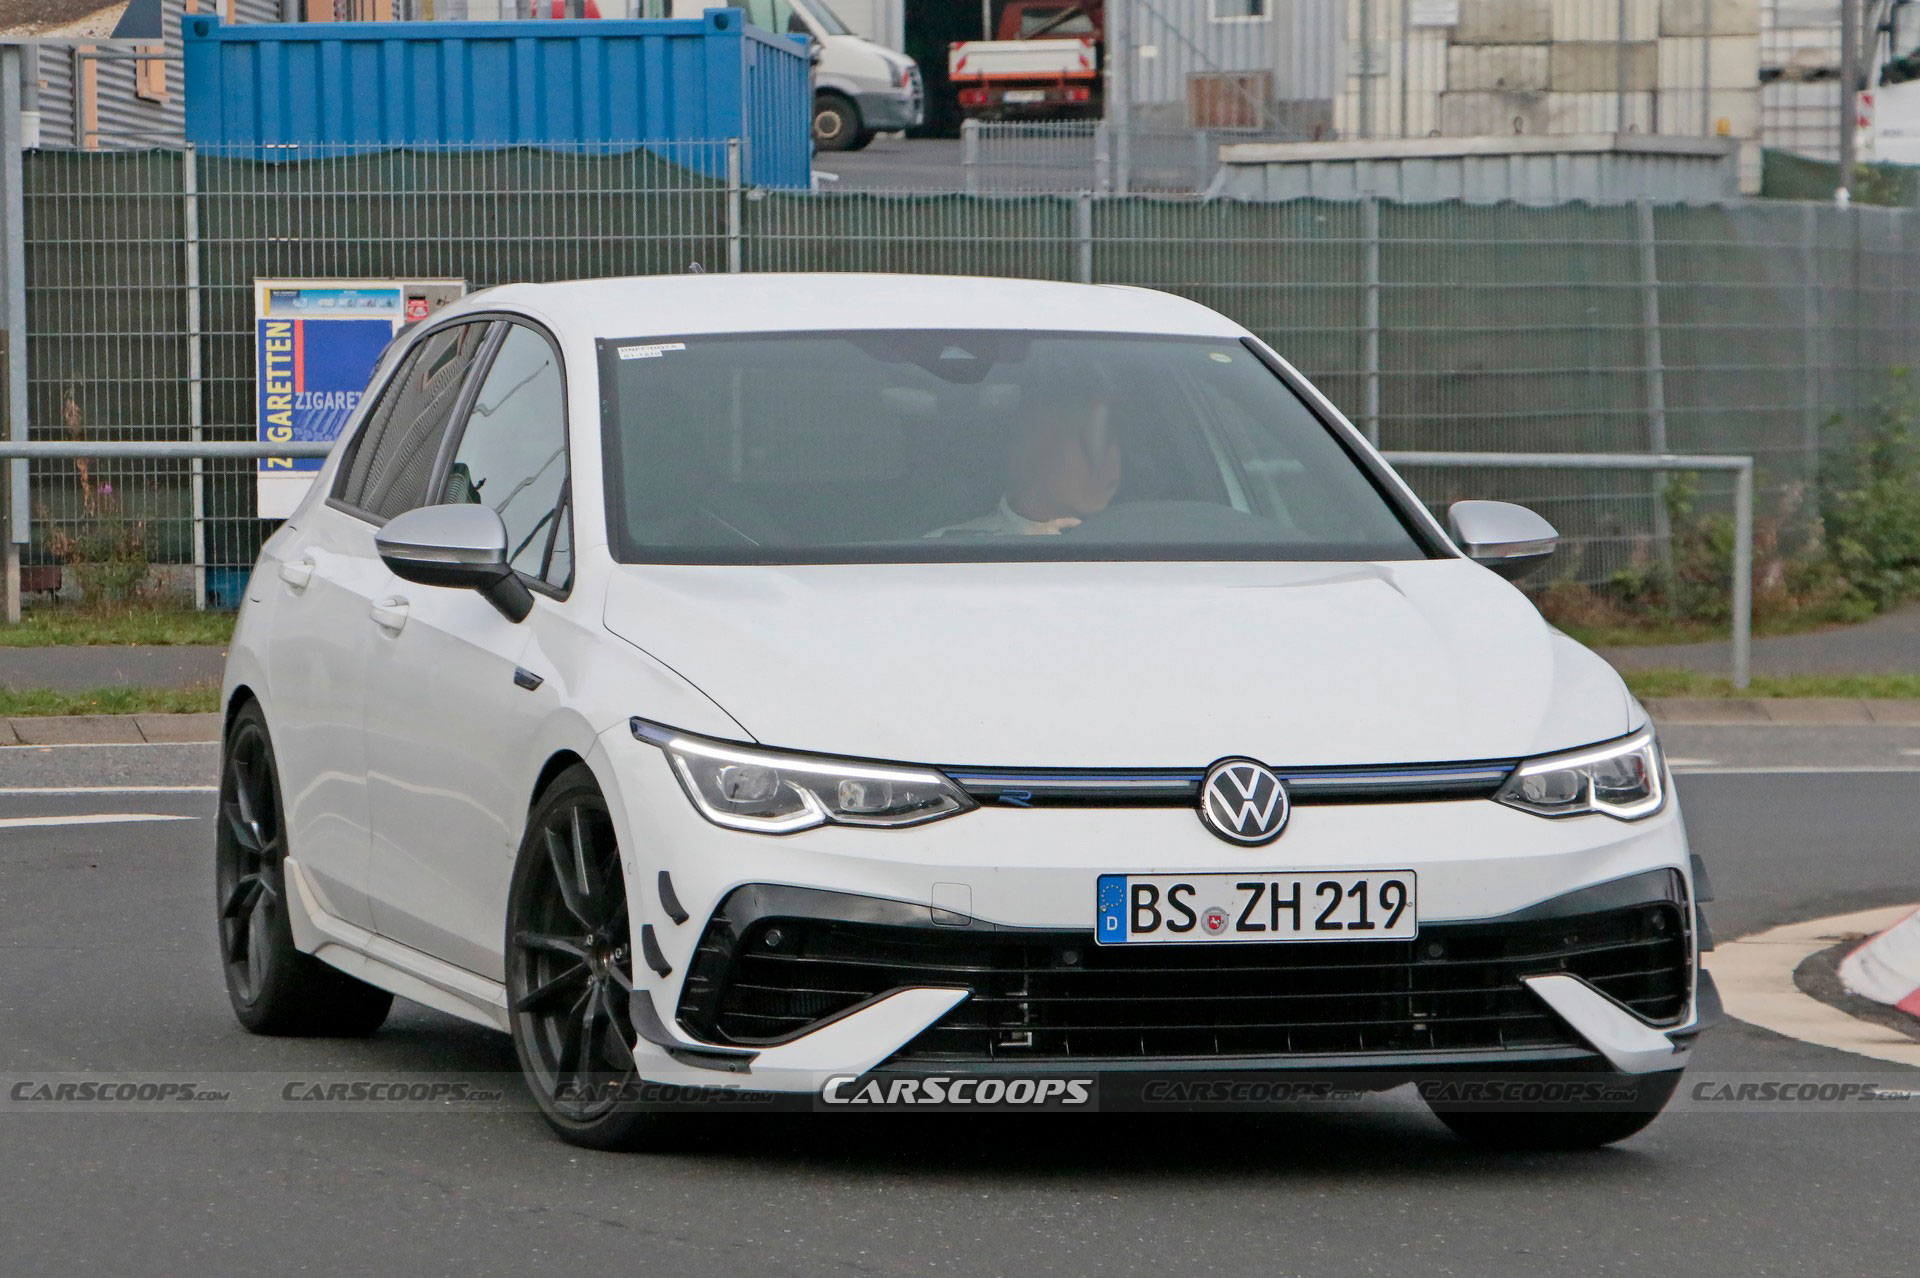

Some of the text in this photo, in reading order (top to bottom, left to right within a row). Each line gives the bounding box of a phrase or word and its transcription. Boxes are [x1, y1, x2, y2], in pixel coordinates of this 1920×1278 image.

[265, 321, 293, 469] ZGARETTEN
[1106, 916, 1118, 931] D
[1131, 879, 1407, 934] BS ZH 219
